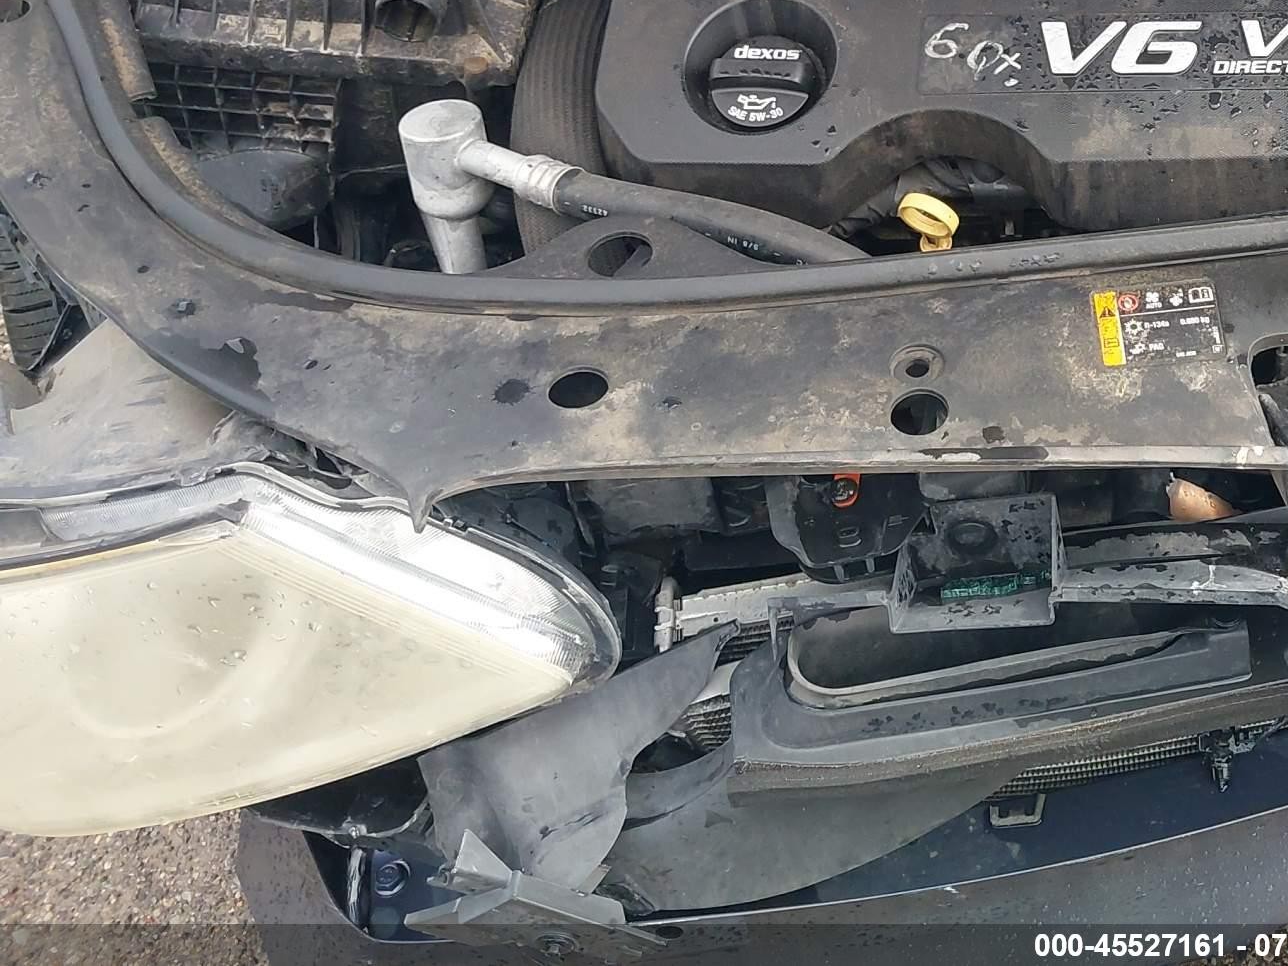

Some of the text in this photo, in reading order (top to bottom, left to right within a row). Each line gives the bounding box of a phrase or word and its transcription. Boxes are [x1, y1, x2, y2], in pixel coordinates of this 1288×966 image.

[924, 22, 970, 59] 6
[1041, 20, 1203, 75] V6
[733, 44, 801, 60] dexos
[727, 105, 784, 122] SAE 5W-30
[727, 235, 738, 245] IN
